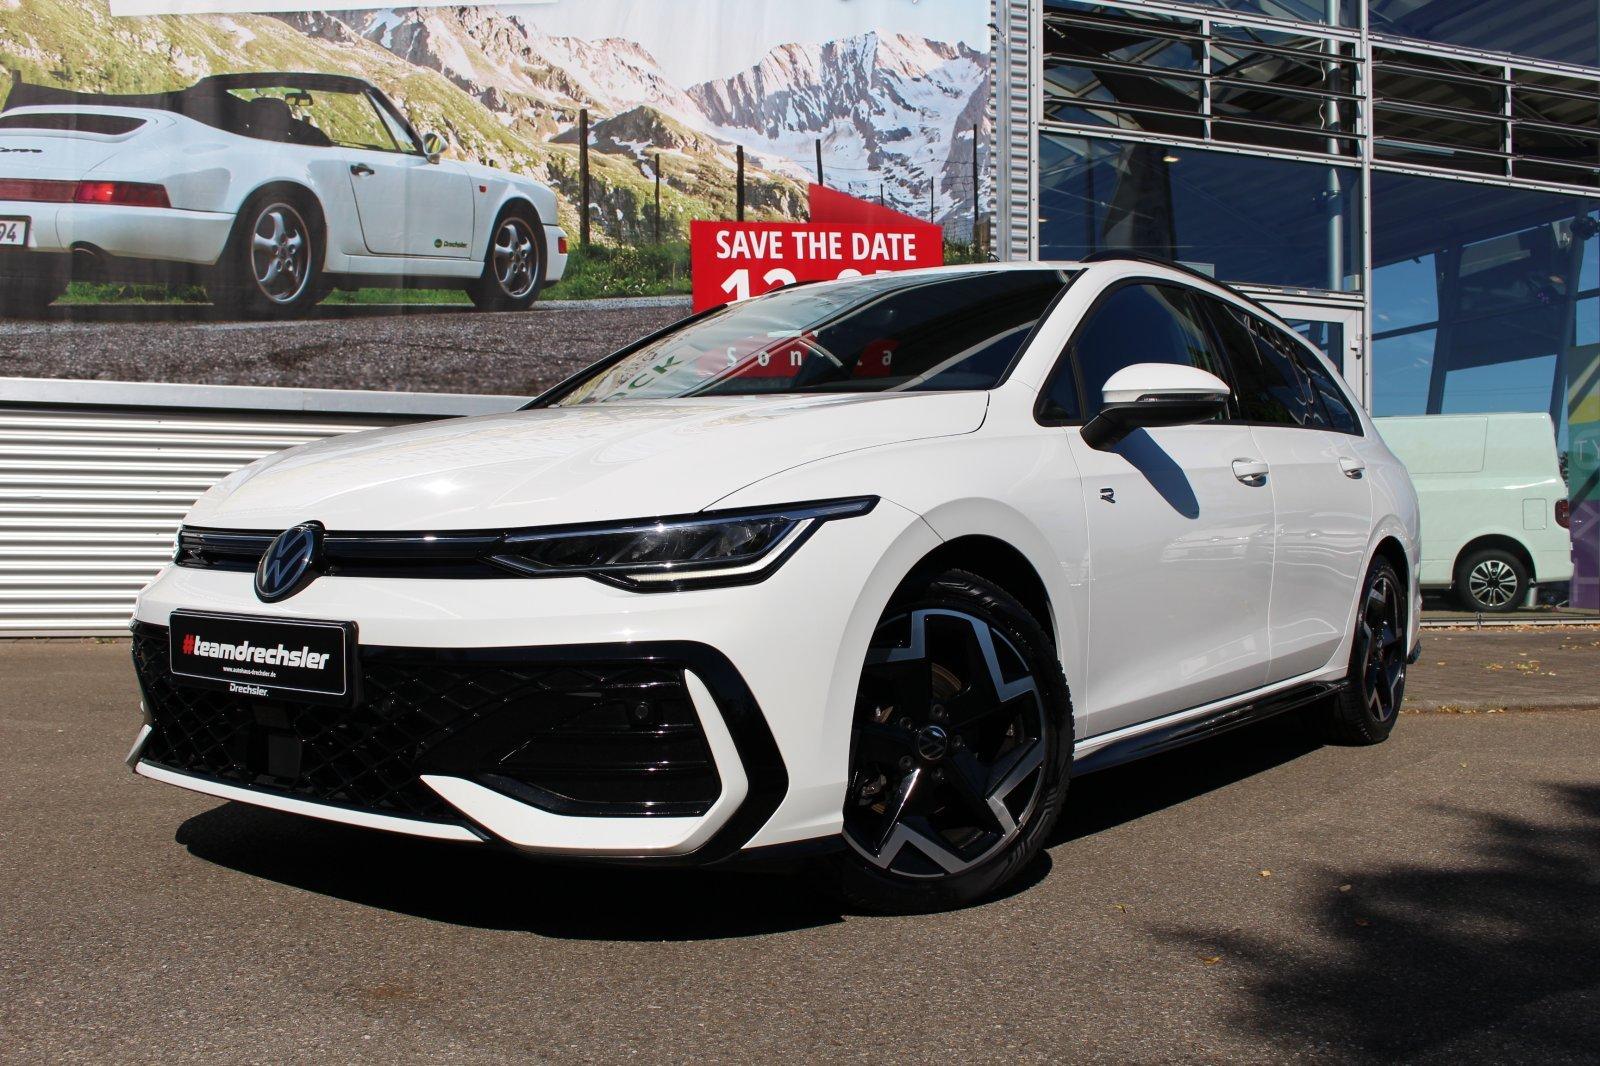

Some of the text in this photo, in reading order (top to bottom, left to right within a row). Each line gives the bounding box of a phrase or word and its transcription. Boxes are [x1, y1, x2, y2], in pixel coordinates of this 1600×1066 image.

[716, 230, 917, 261] SAVE THE DATE
[182, 633, 330, 670] #teamdrechsler
[222, 666, 277, 678] www.autohaus-drechsler.de
